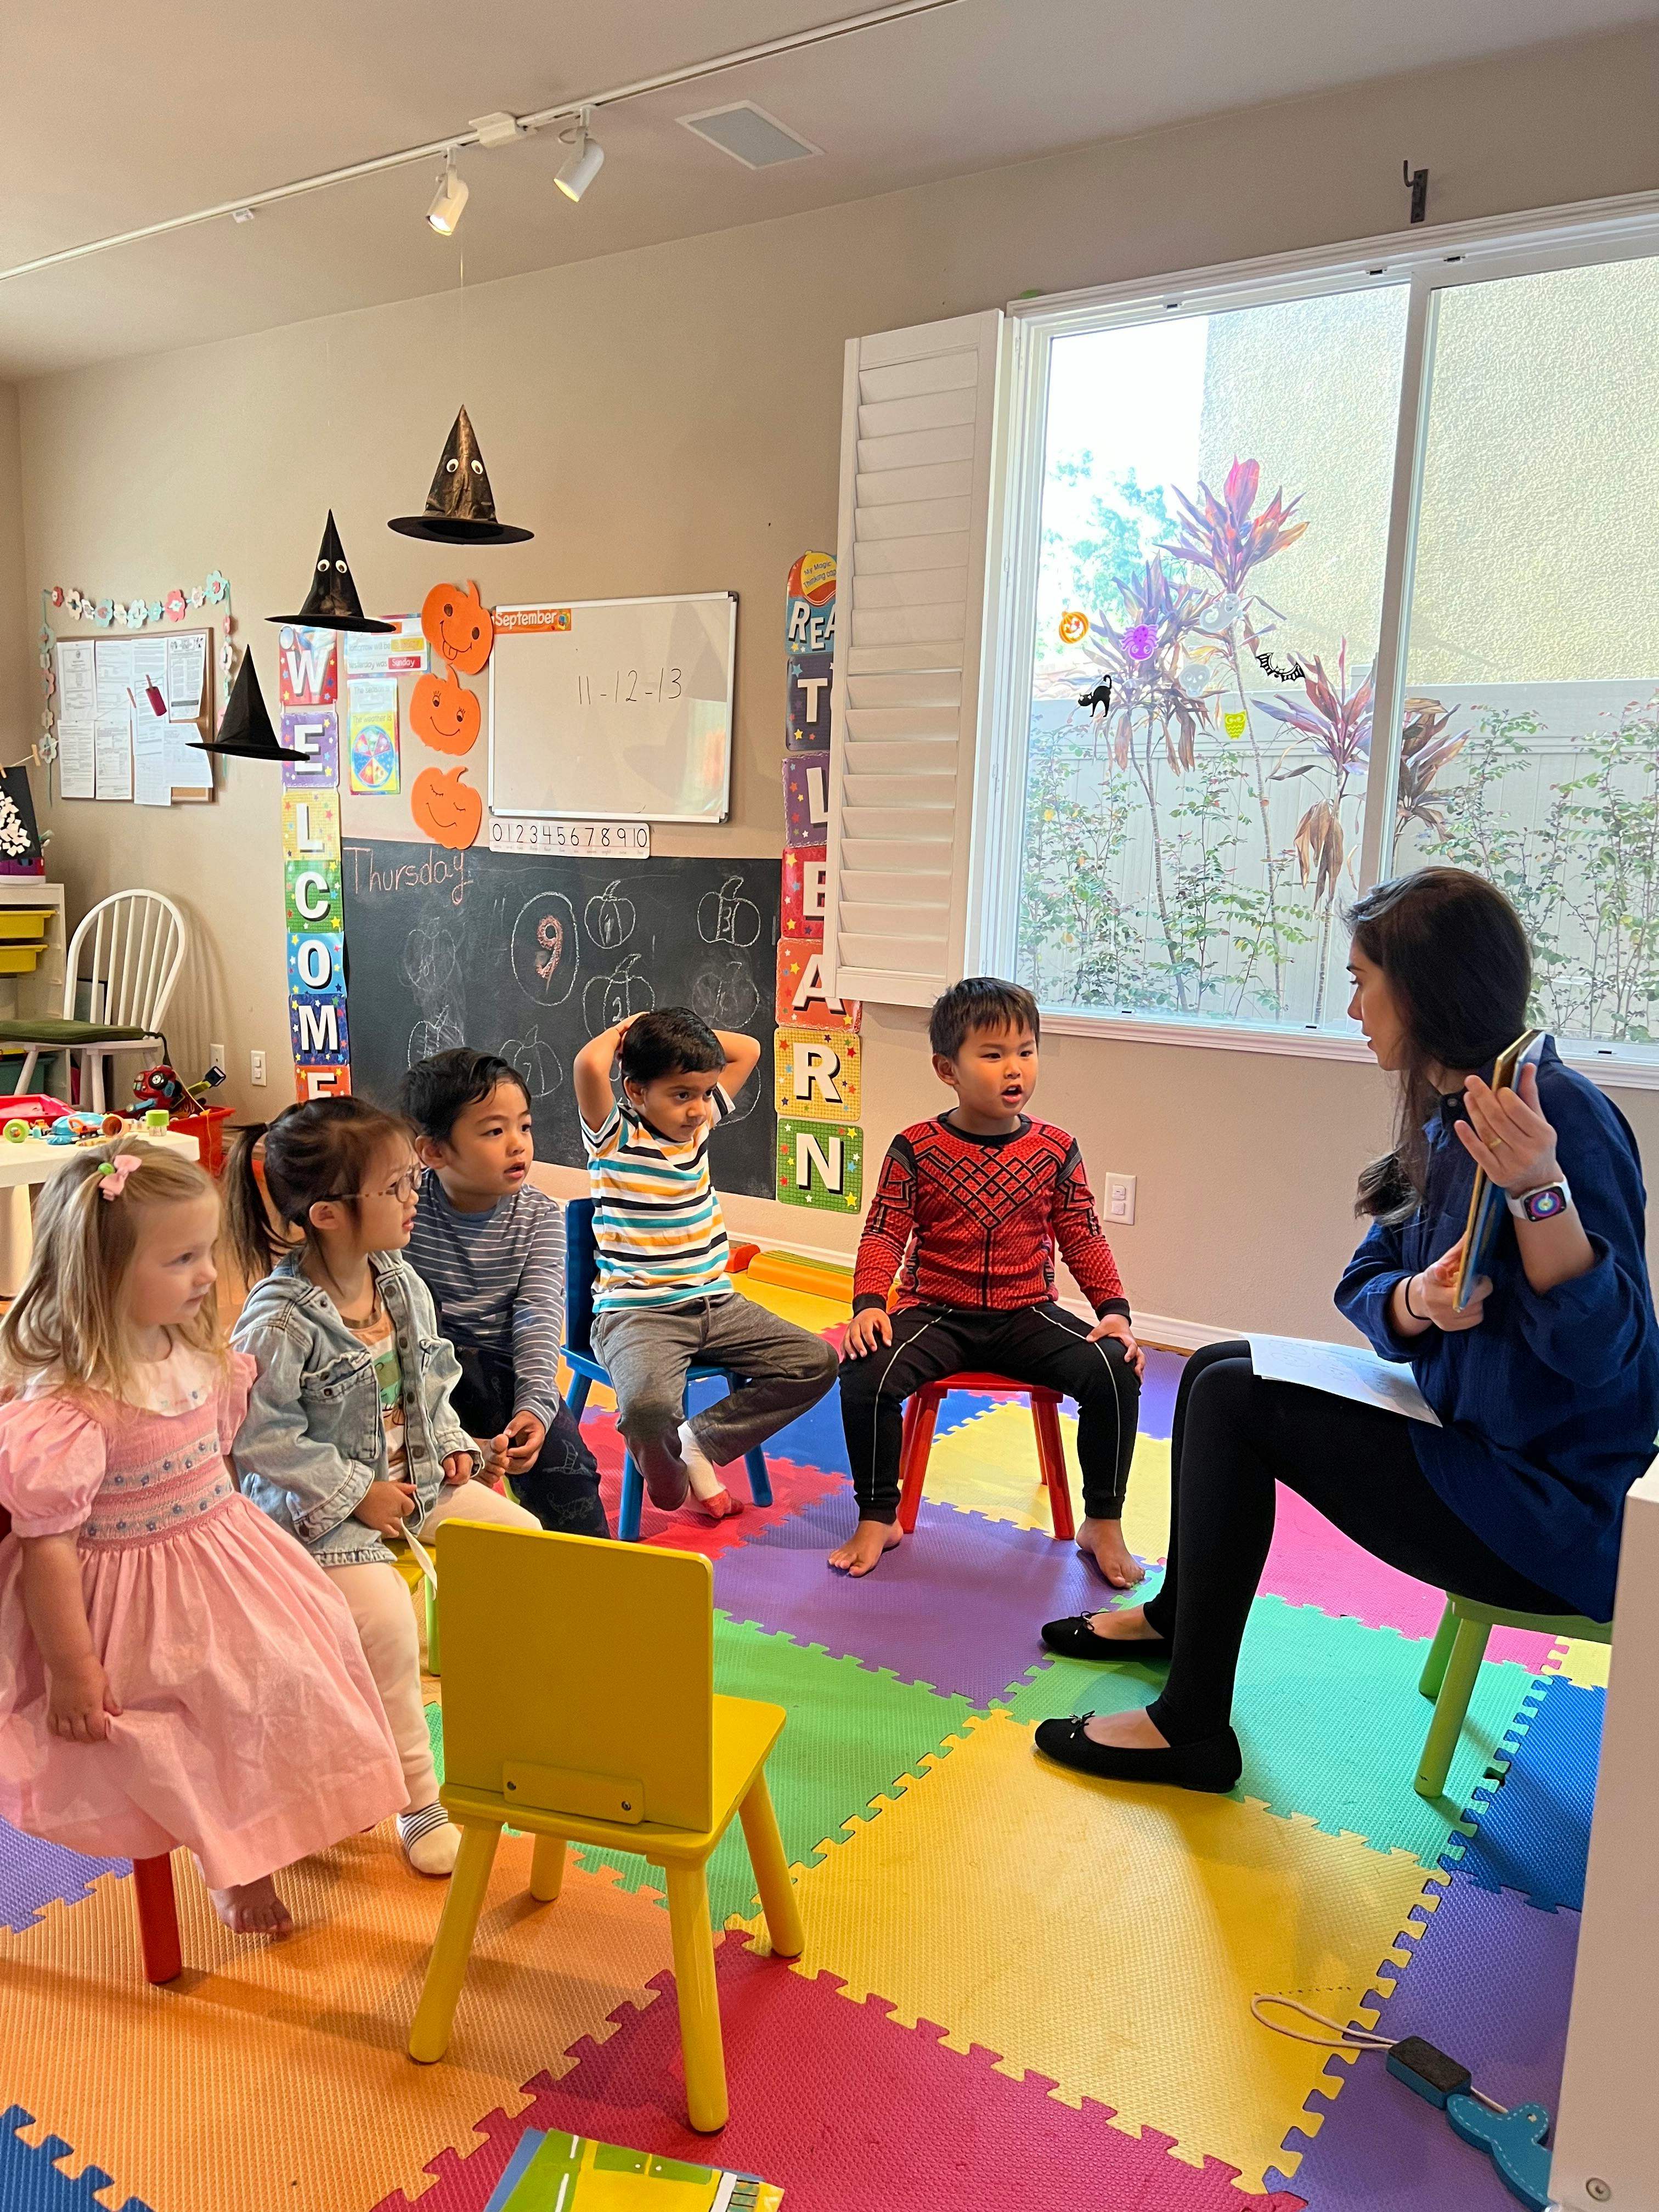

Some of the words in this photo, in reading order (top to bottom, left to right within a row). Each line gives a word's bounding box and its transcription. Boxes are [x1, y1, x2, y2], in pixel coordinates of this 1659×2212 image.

[814, 562, 831, 570] Magic
[495, 610, 557, 630] September
[392, 658, 415, 668] Sunday
[343, 847, 474, 905] Thursday
[722, 906, 732, 933] 3
[536, 914, 563, 986] 9
[612, 996, 624, 1022] 2
[523, 1062, 532, 1084] 7
